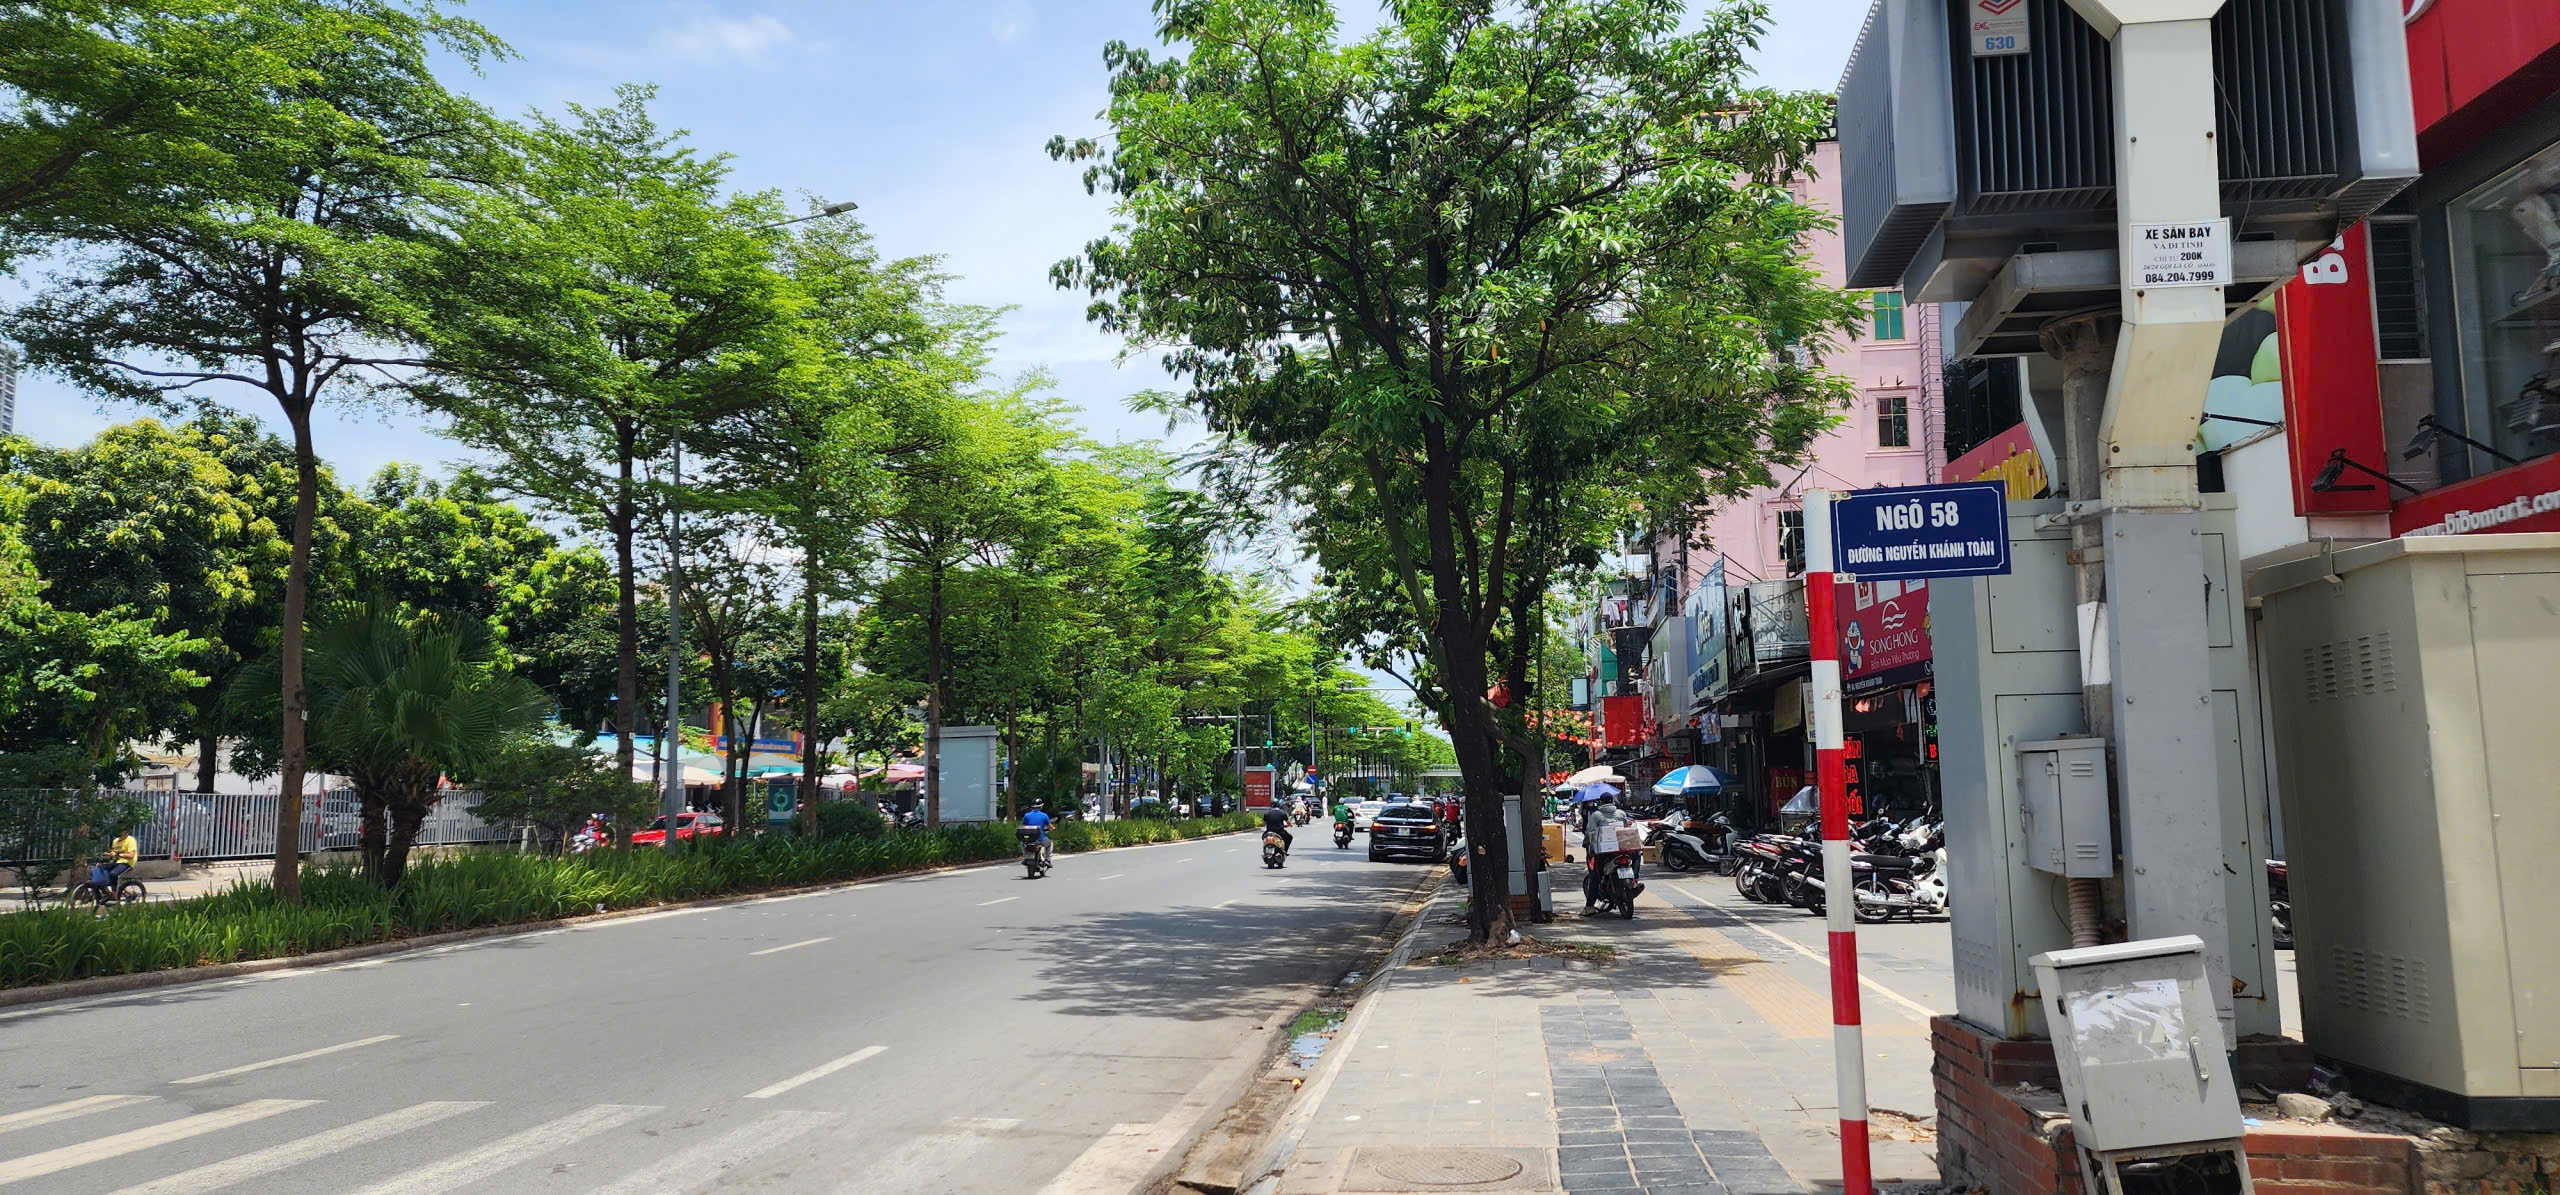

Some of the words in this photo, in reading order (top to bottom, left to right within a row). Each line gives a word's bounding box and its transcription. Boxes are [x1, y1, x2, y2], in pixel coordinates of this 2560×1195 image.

[1985, 36, 2015, 50] 630
[2145, 229, 2159, 240] XE
[2162, 226, 2186, 239] SÂN
[2189, 227, 2211, 238] BAY
[2180, 251, 2203, 261] 200K
[2145, 270, 2214, 283] 084.204.7999
[1875, 498, 1924, 531] NGÕ
[1930, 501, 1960, 528] 58
[1847, 543, 1883, 564] ĐƯỜNG
[1885, 538, 1927, 561] NGUYỄN
[1929, 537, 1965, 559] KHÁNH
[1966, 537, 1995, 557] TOÀN
